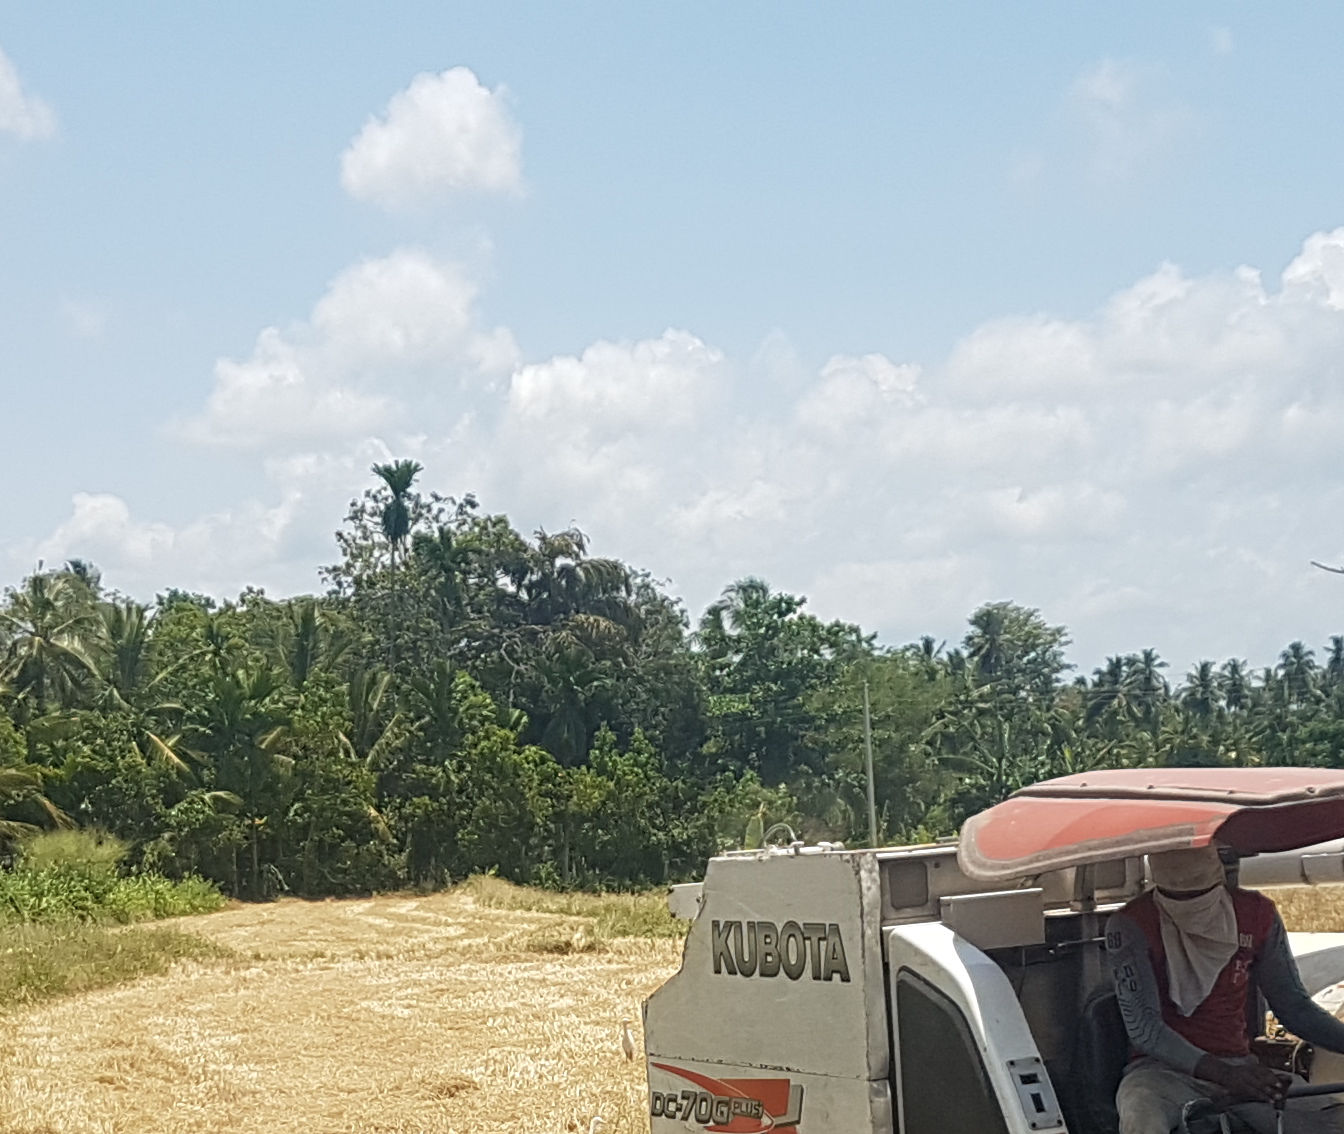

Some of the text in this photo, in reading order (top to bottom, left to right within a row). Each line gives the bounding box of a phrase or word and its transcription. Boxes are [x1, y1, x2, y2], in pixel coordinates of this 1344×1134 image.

[711, 920, 851, 983] KUBOTA
[651, 1090, 762, 1126] DC-70G PLUS
